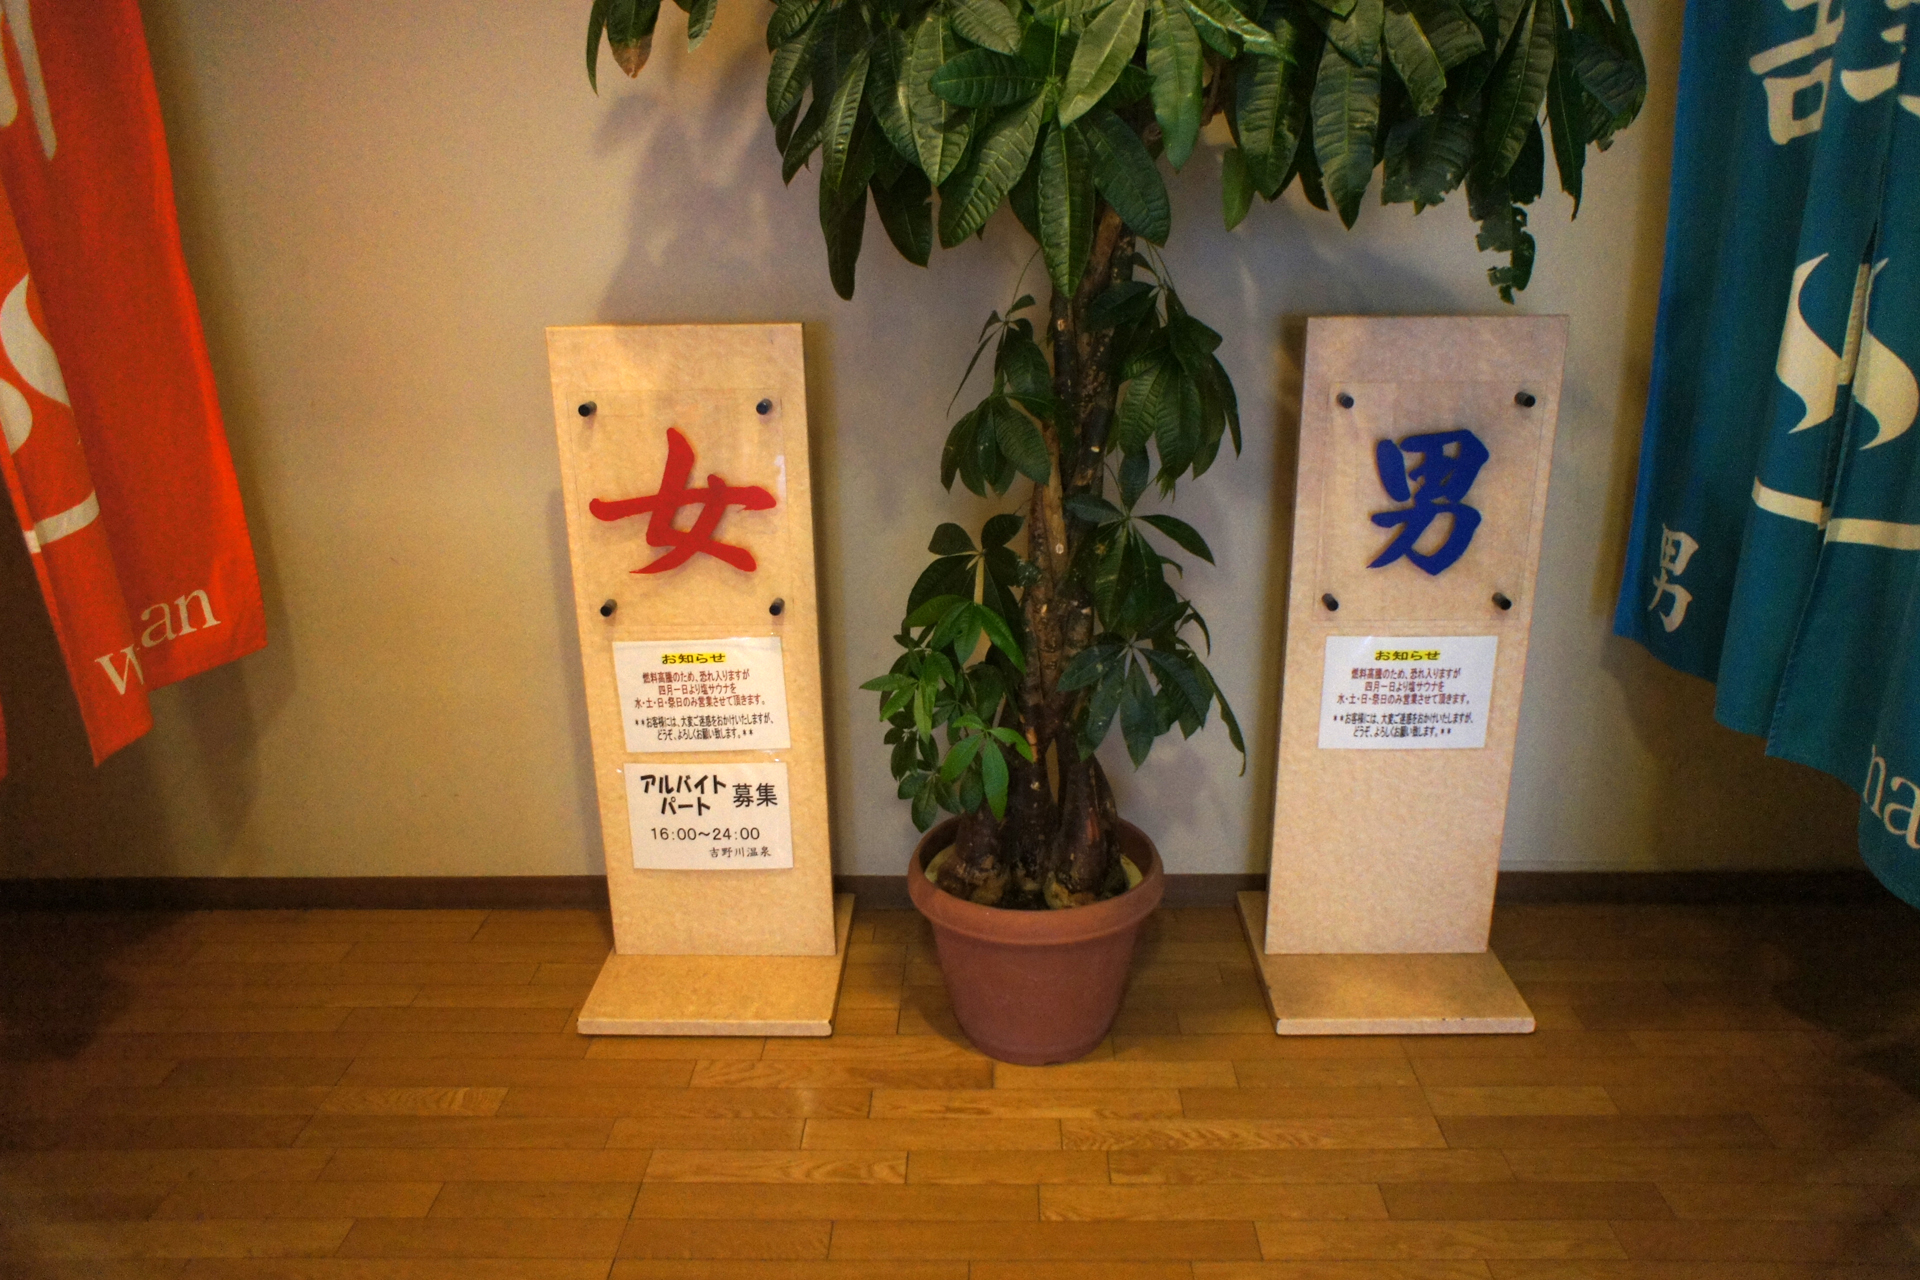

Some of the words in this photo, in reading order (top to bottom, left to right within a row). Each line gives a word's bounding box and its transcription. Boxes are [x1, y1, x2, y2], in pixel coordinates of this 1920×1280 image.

[589, 427, 777, 574] 女
[1366, 429, 1490, 576] 男
[1647, 523, 1699, 632] 男
[662, 653, 726, 664] お知らせ
[1375, 650, 1441, 661] お知らせ
[640, 774, 727, 794] アルバイト
[732, 783, 778, 808] 募集
[661, 797, 711, 816] パート
[709, 846, 771, 858] 吉野川温泉
